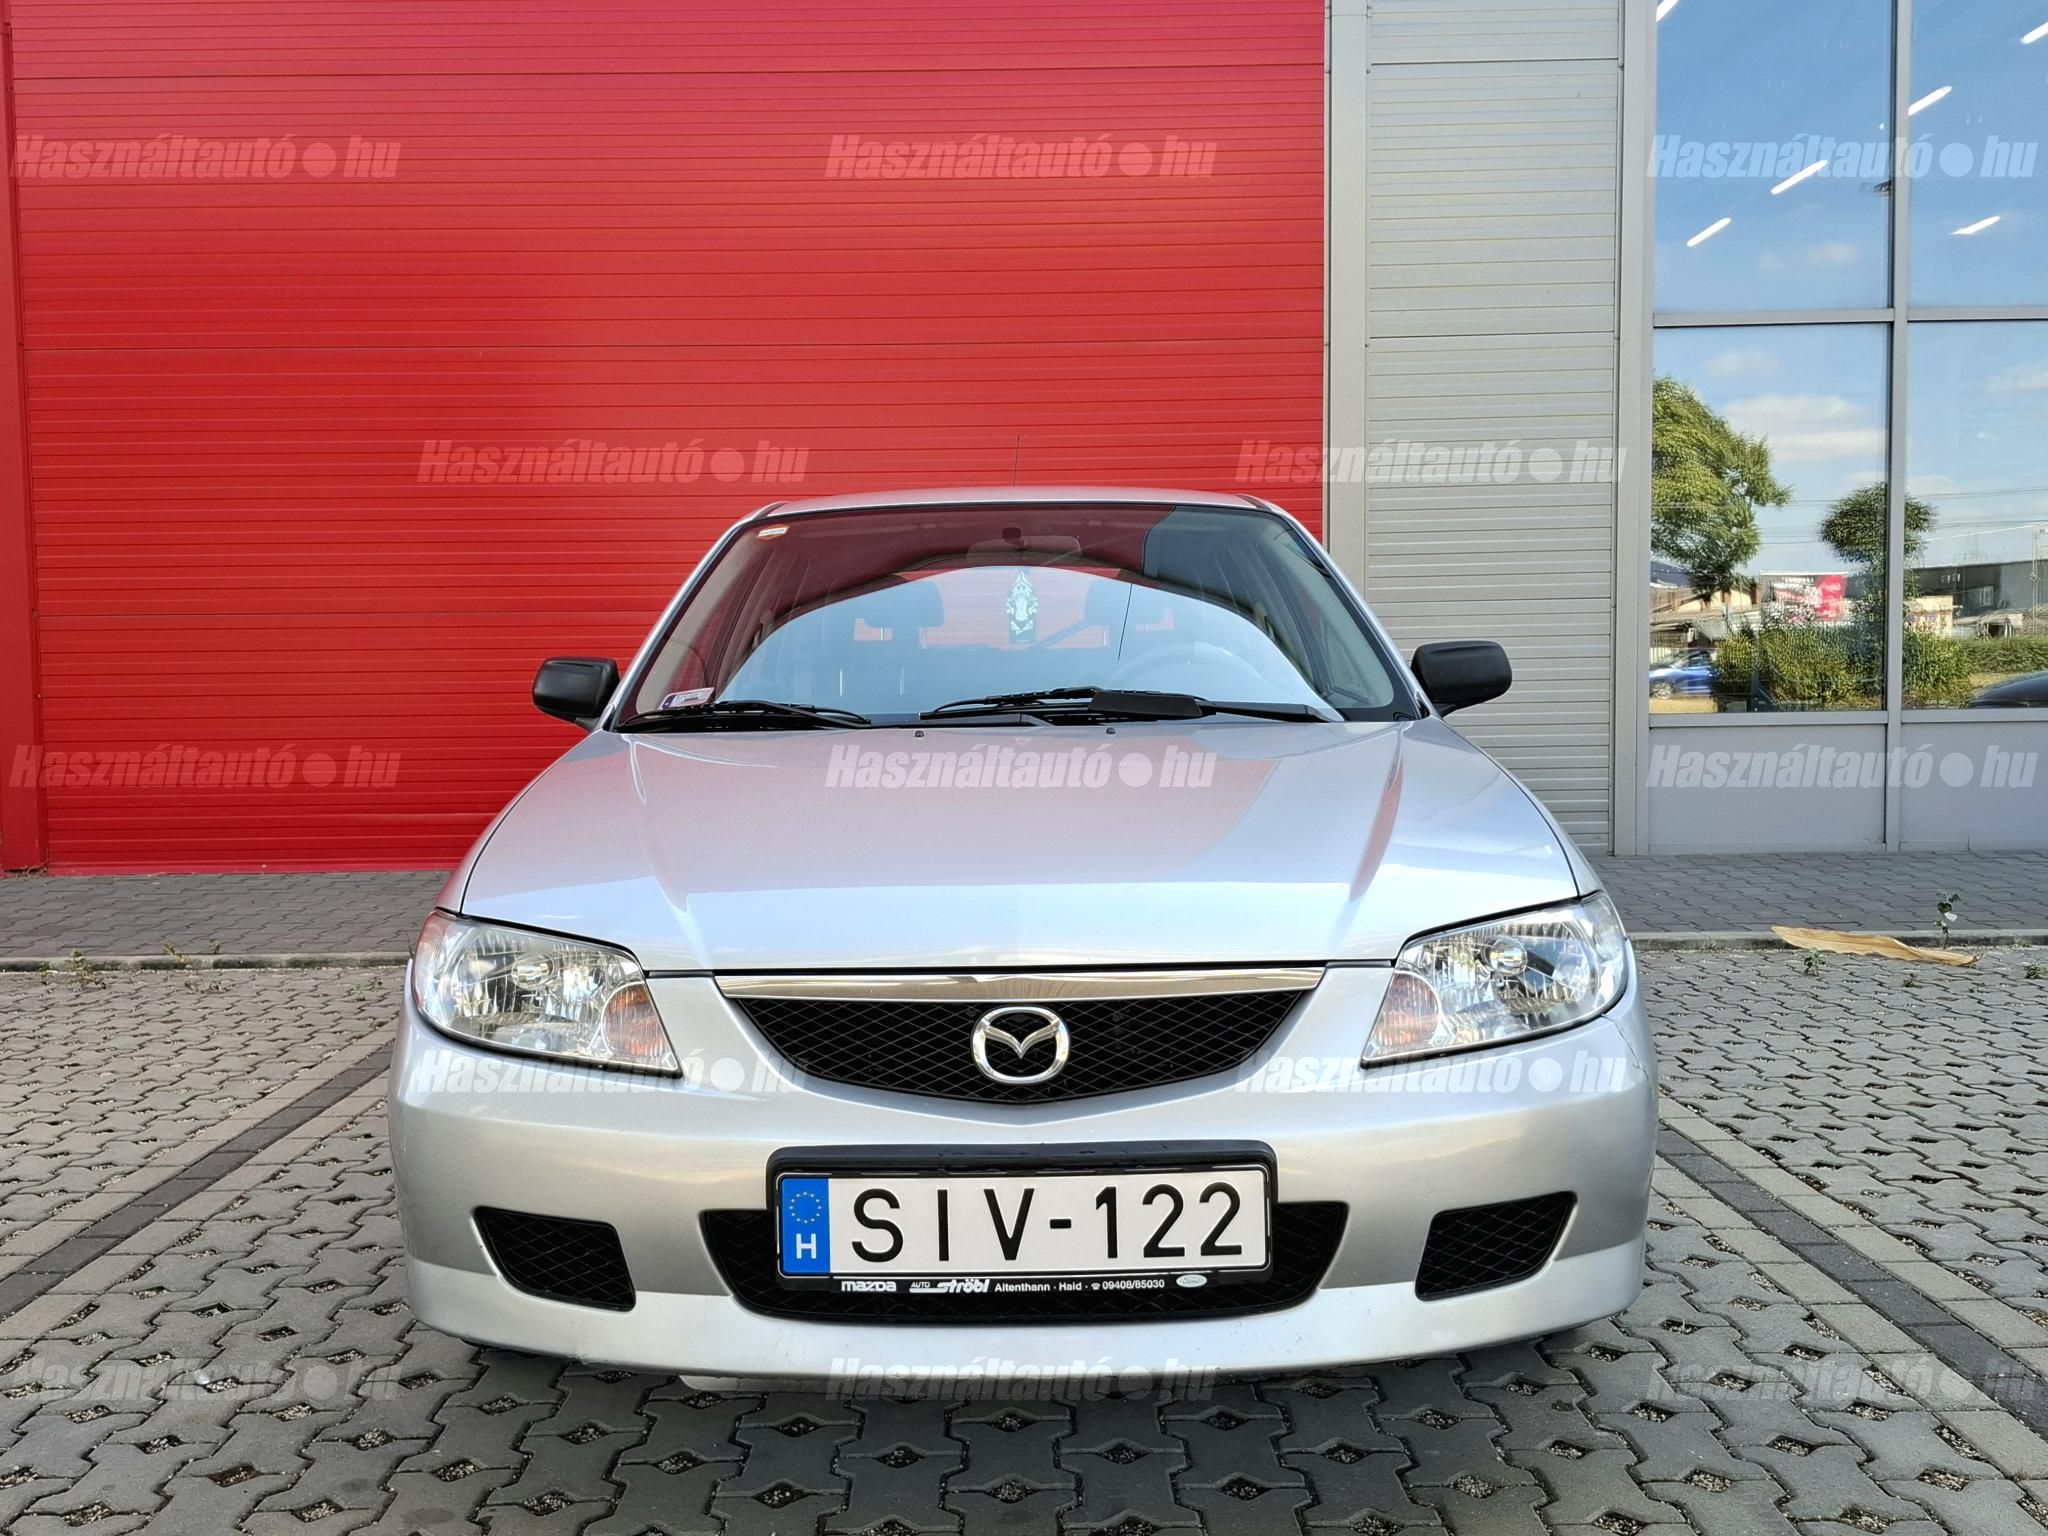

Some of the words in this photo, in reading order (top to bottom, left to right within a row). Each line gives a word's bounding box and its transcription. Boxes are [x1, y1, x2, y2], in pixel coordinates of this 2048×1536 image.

[851, 1182, 1243, 1262] SIV-122
[796, 1233, 817, 1259] H
[1102, 1279, 1165, 1290] 09408/85030
